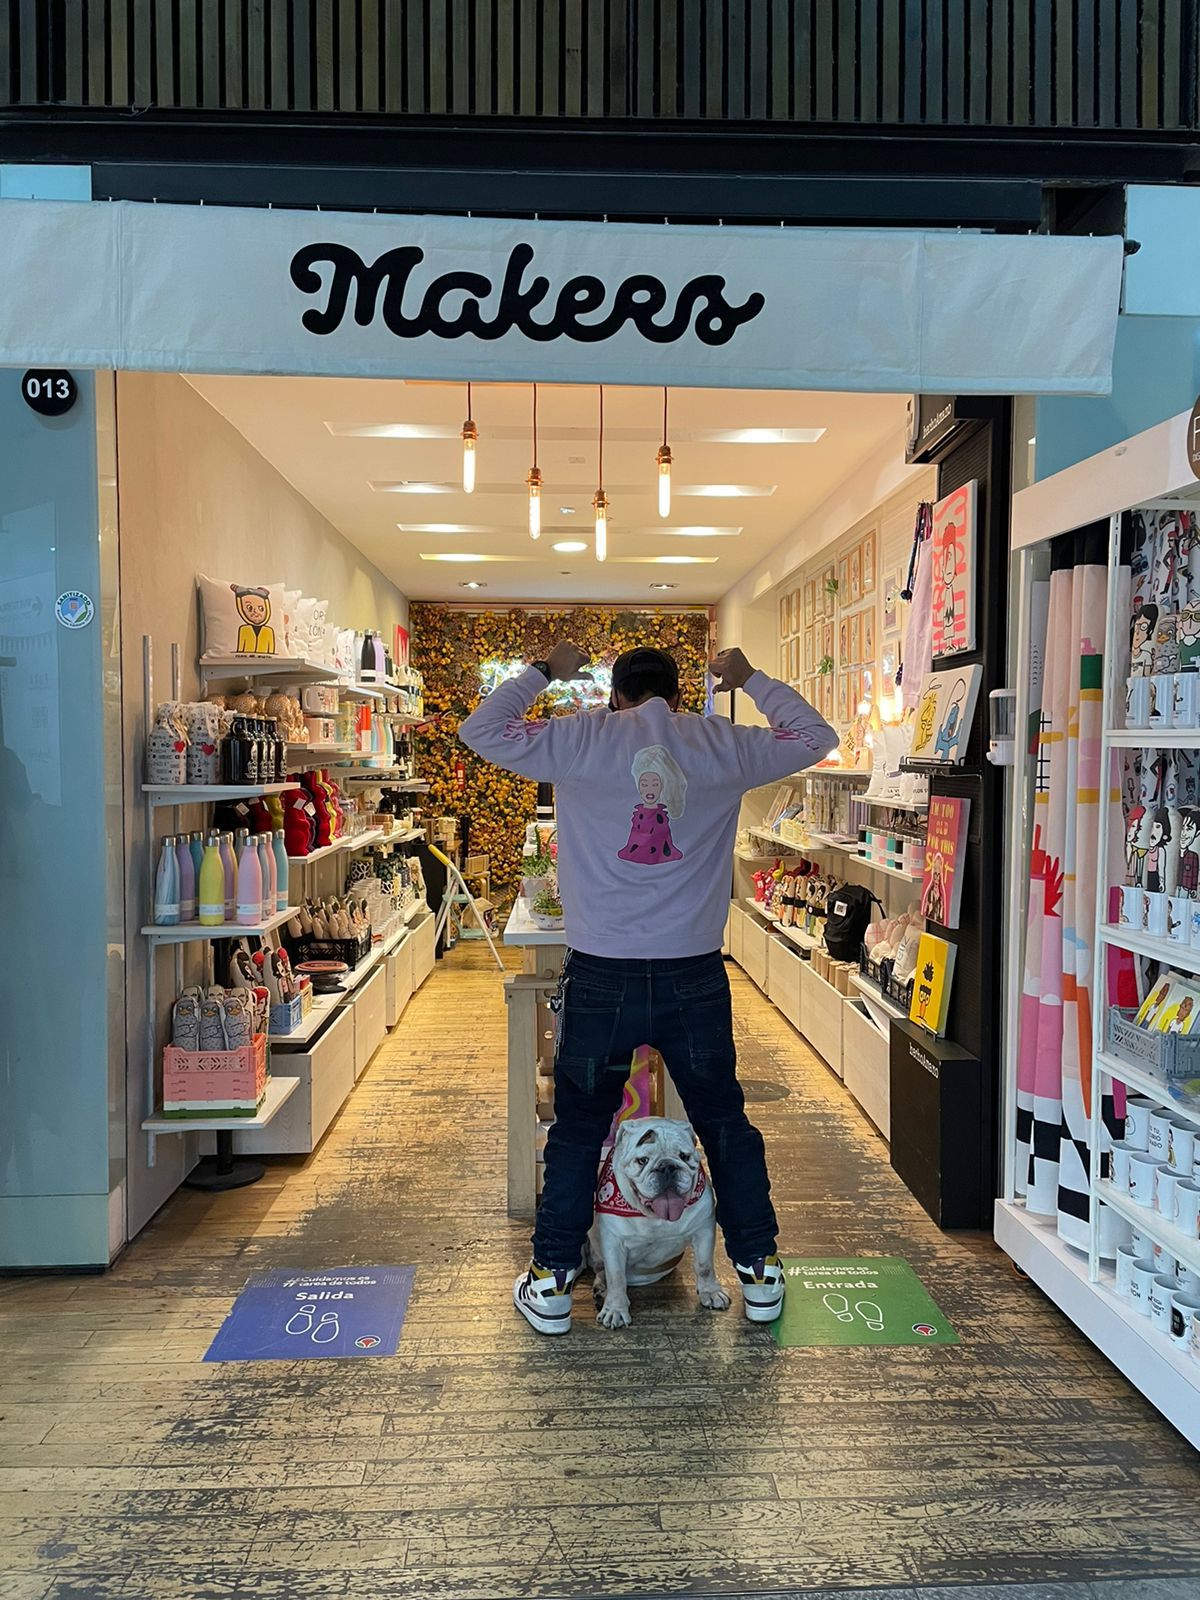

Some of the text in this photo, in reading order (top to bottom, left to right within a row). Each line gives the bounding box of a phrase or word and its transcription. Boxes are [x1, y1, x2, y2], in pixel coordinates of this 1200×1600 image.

[290, 242, 765, 345] Makers
[27, 378, 70, 399] 013
[940, 840, 955, 856] THIS
[803, 1280, 879, 1289] Entrada
[295, 1291, 354, 1300] Salida
